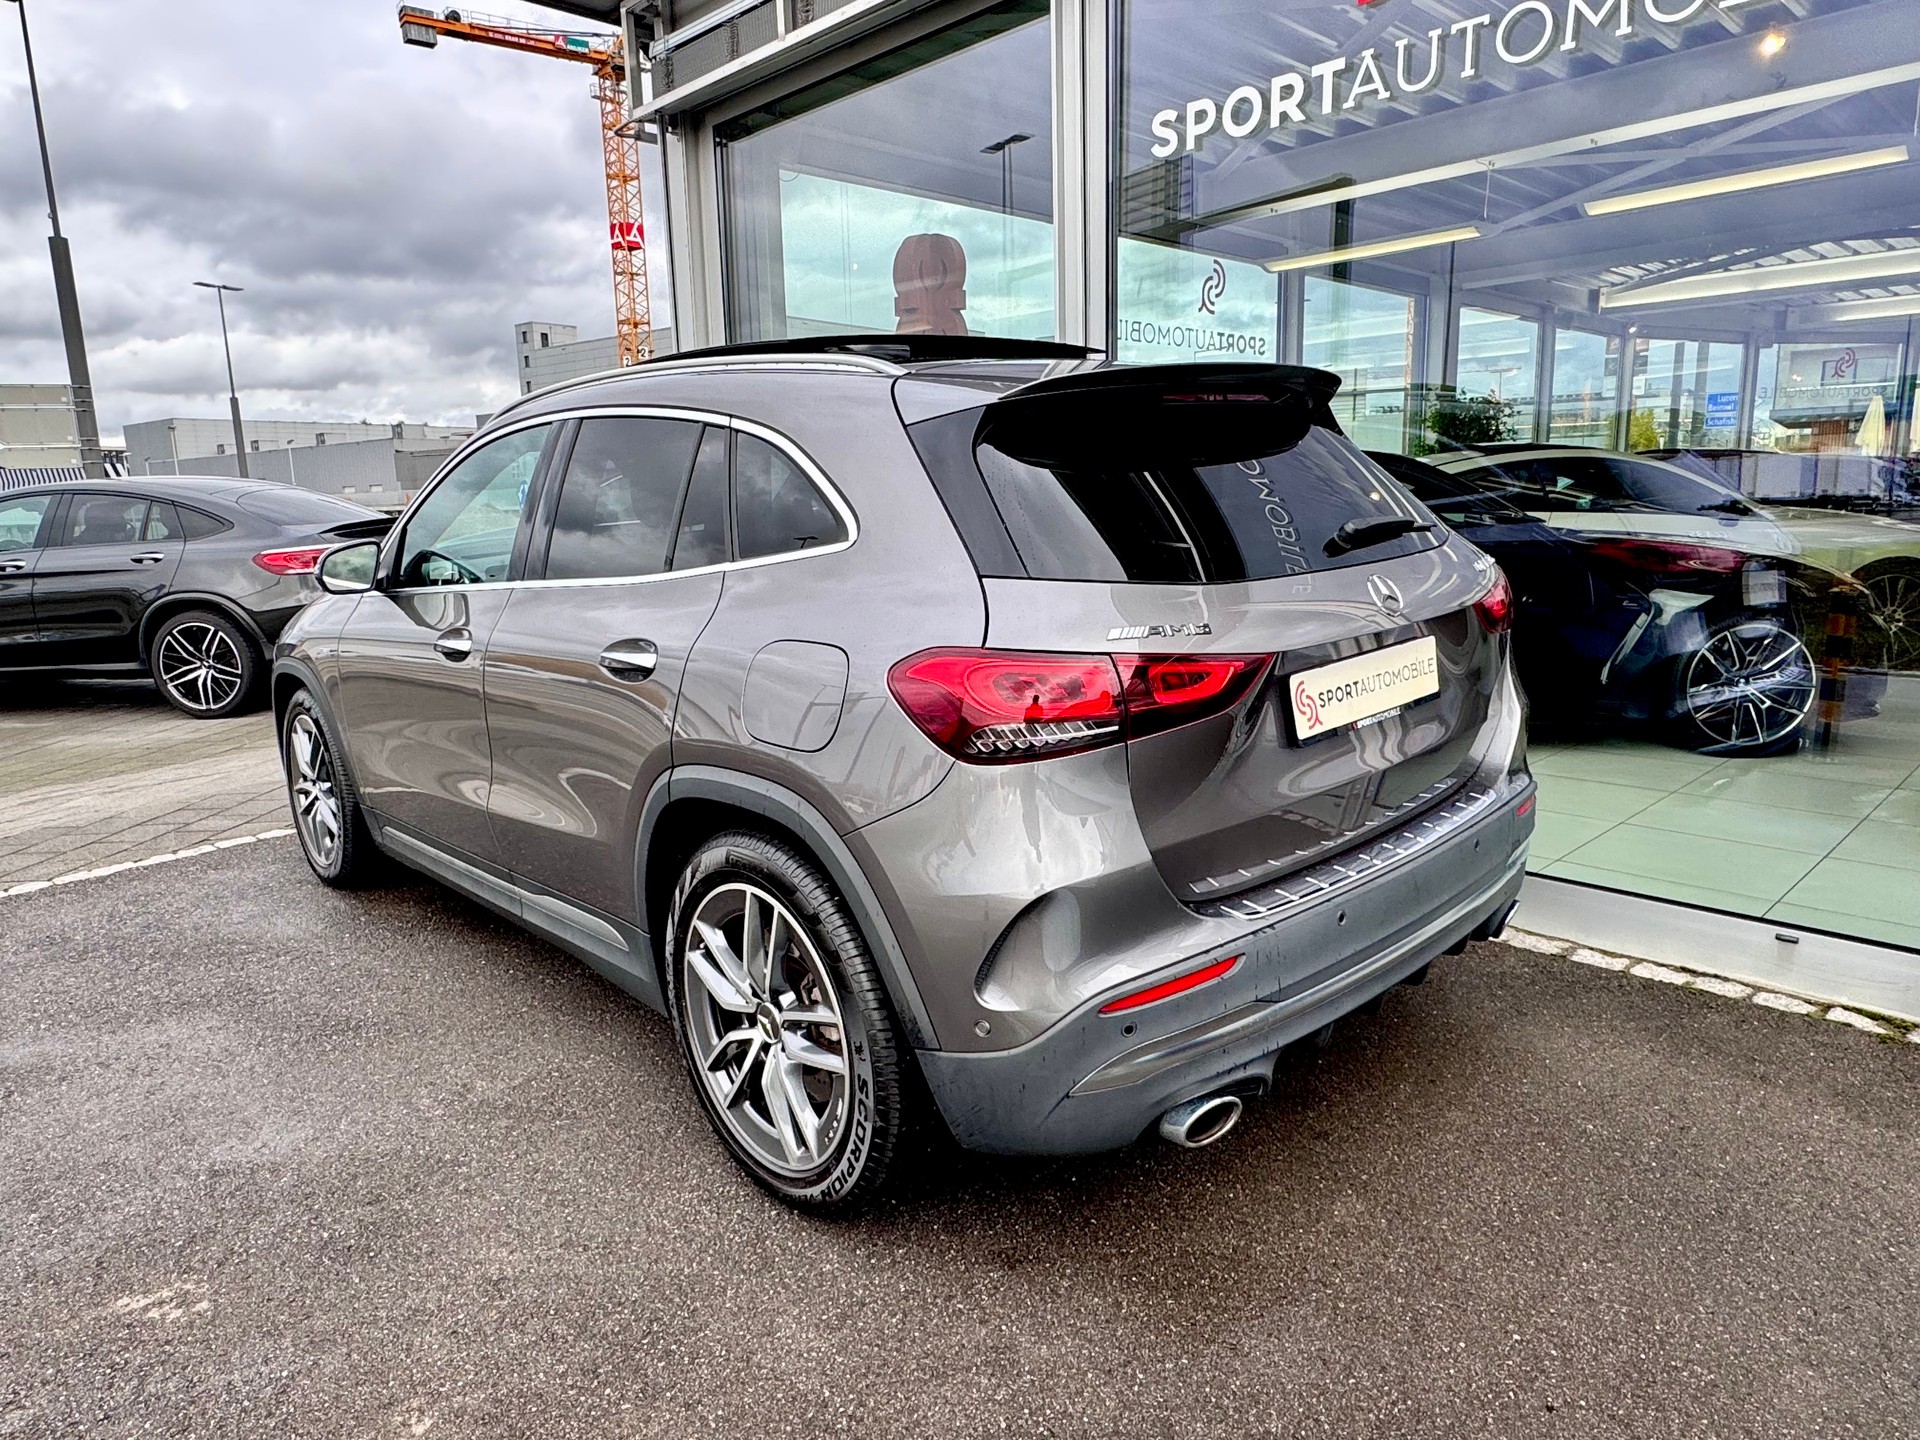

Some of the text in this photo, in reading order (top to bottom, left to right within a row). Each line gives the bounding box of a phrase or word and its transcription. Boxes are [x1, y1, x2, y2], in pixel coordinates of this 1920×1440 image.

[1151, 0, 1755, 158] SPORTAUTOM
[1318, 657, 1435, 709] SPORTAUTOMOBILE
[820, 1073, 870, 1201] SCORPION
